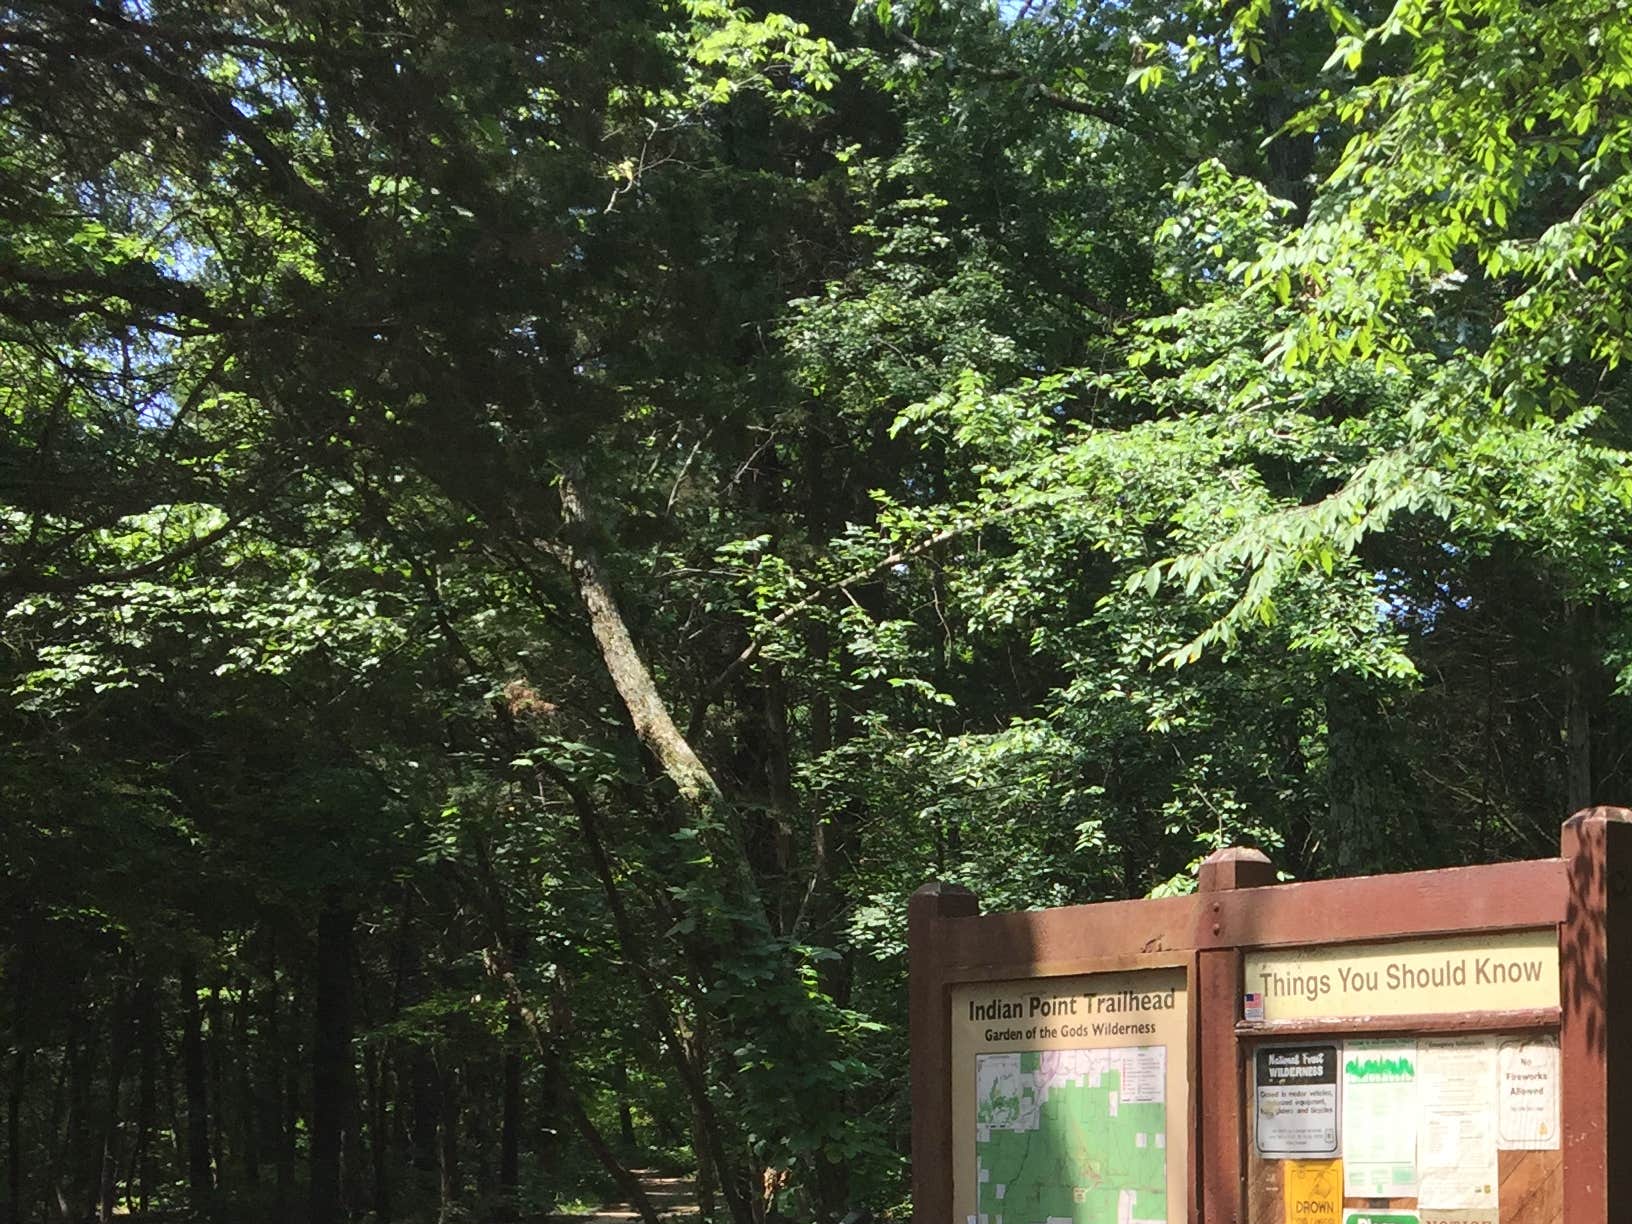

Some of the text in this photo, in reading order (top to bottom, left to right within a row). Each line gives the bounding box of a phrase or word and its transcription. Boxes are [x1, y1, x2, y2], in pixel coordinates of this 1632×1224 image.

[1259, 957, 1542, 1001] Things You Should Know
[969, 988, 1175, 1021] Indian Point Trailhead
[985, 1022, 1156, 1042] Garden of the Gods Wilderness
[1268, 1065, 1324, 1079] WILDERNESS
[1296, 1201, 1334, 1214] DROWN
